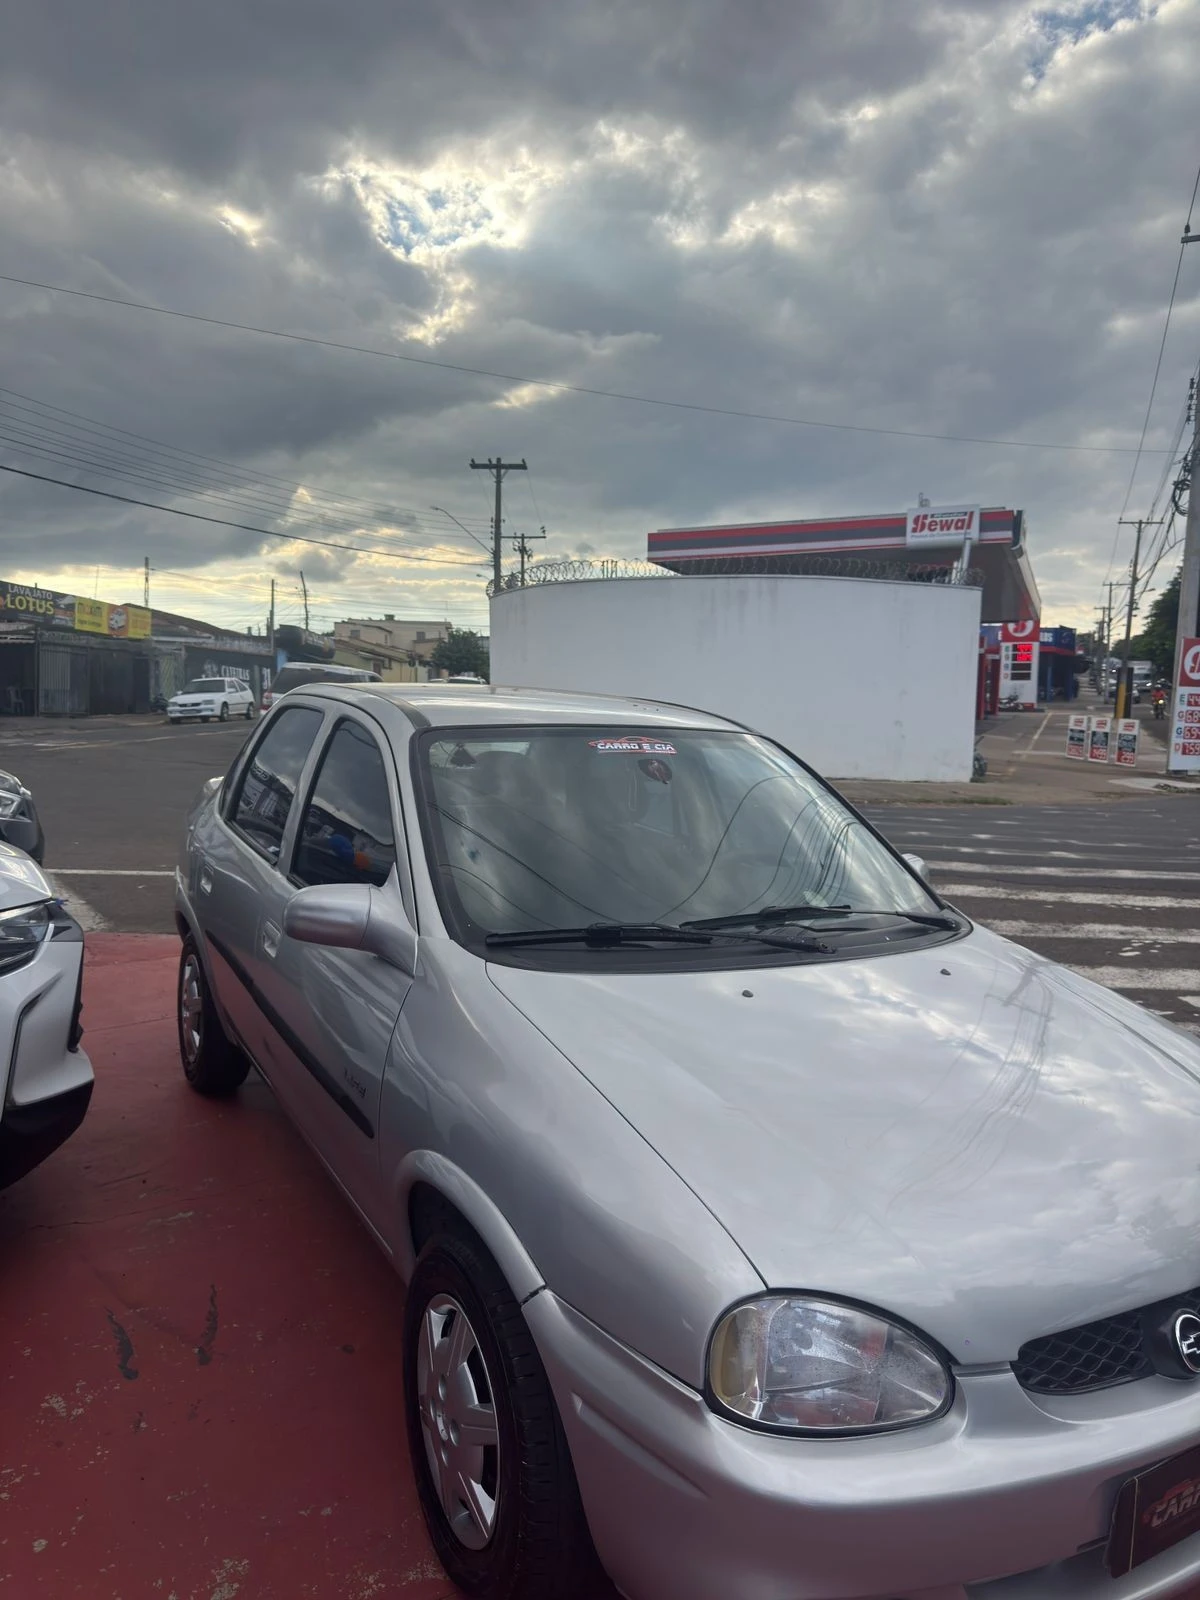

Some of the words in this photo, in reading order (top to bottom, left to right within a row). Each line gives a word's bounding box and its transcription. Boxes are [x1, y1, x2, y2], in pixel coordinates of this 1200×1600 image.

[911, 511, 975, 533] Sewal
[6, 593, 54, 615] LOTUS
[1187, 710, 1200, 723] 68
[1176, 727, 1182, 735] G
[597, 742, 640, 750] CARRO
[655, 743, 675, 751] CIA
